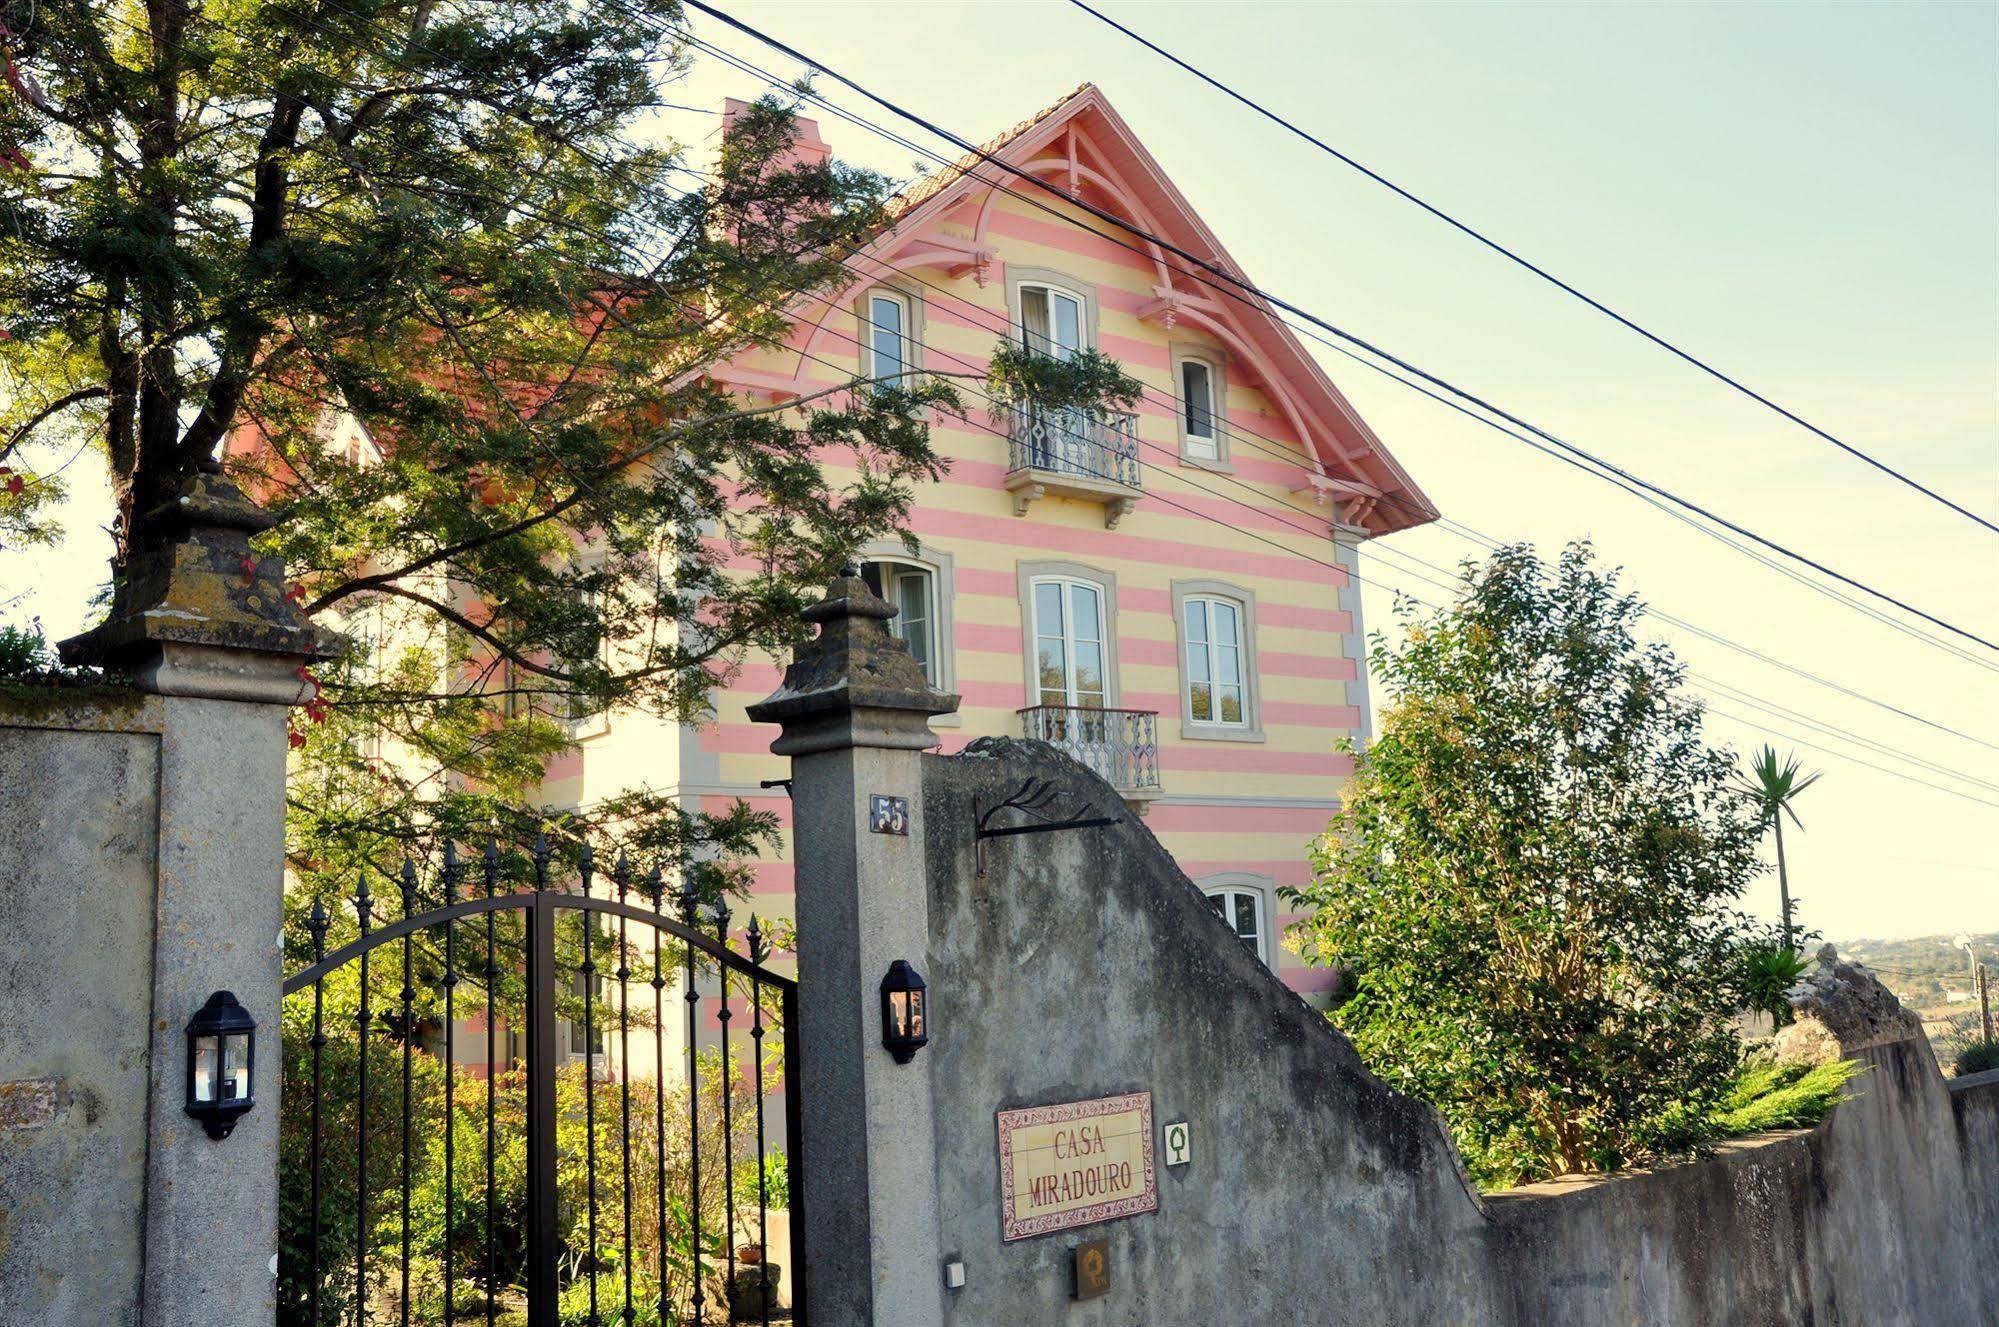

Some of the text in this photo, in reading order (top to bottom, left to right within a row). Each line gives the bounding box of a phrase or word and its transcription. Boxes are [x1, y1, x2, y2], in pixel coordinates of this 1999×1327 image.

[878, 798, 903, 831] 55
[1055, 1124, 1105, 1159] CASA
[1029, 1161, 1132, 1208] MIRADOURO
